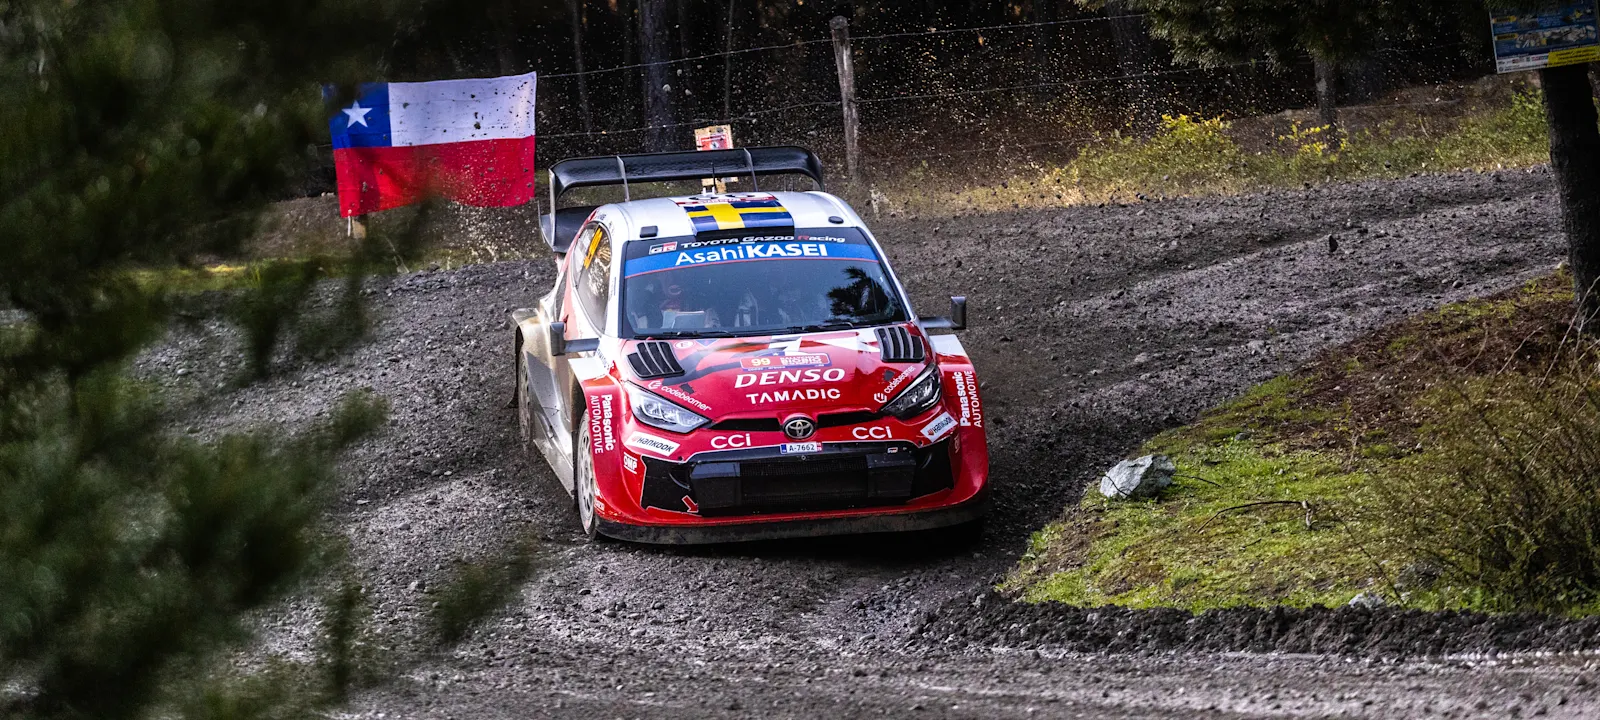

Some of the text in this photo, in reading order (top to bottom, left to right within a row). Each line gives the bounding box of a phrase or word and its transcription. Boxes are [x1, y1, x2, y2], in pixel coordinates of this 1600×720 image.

[681, 235, 846, 249] TOYOTA GAZOO Racing
[750, 357, 771, 367] 99
[734, 368, 846, 389] DENSO
[884, 365, 916, 394] codebeamer
[661, 385, 712, 411] codebeamer
[746, 388, 841, 405] TAMADIC
[958, 371, 972, 427] Panasonic
[965, 370, 982, 428] AUTOMOTIVE
[590, 395, 604, 455] AUTOMOTIVE
[601, 394, 617, 452] Panasonic
[788, 443, 816, 453] A-7662
